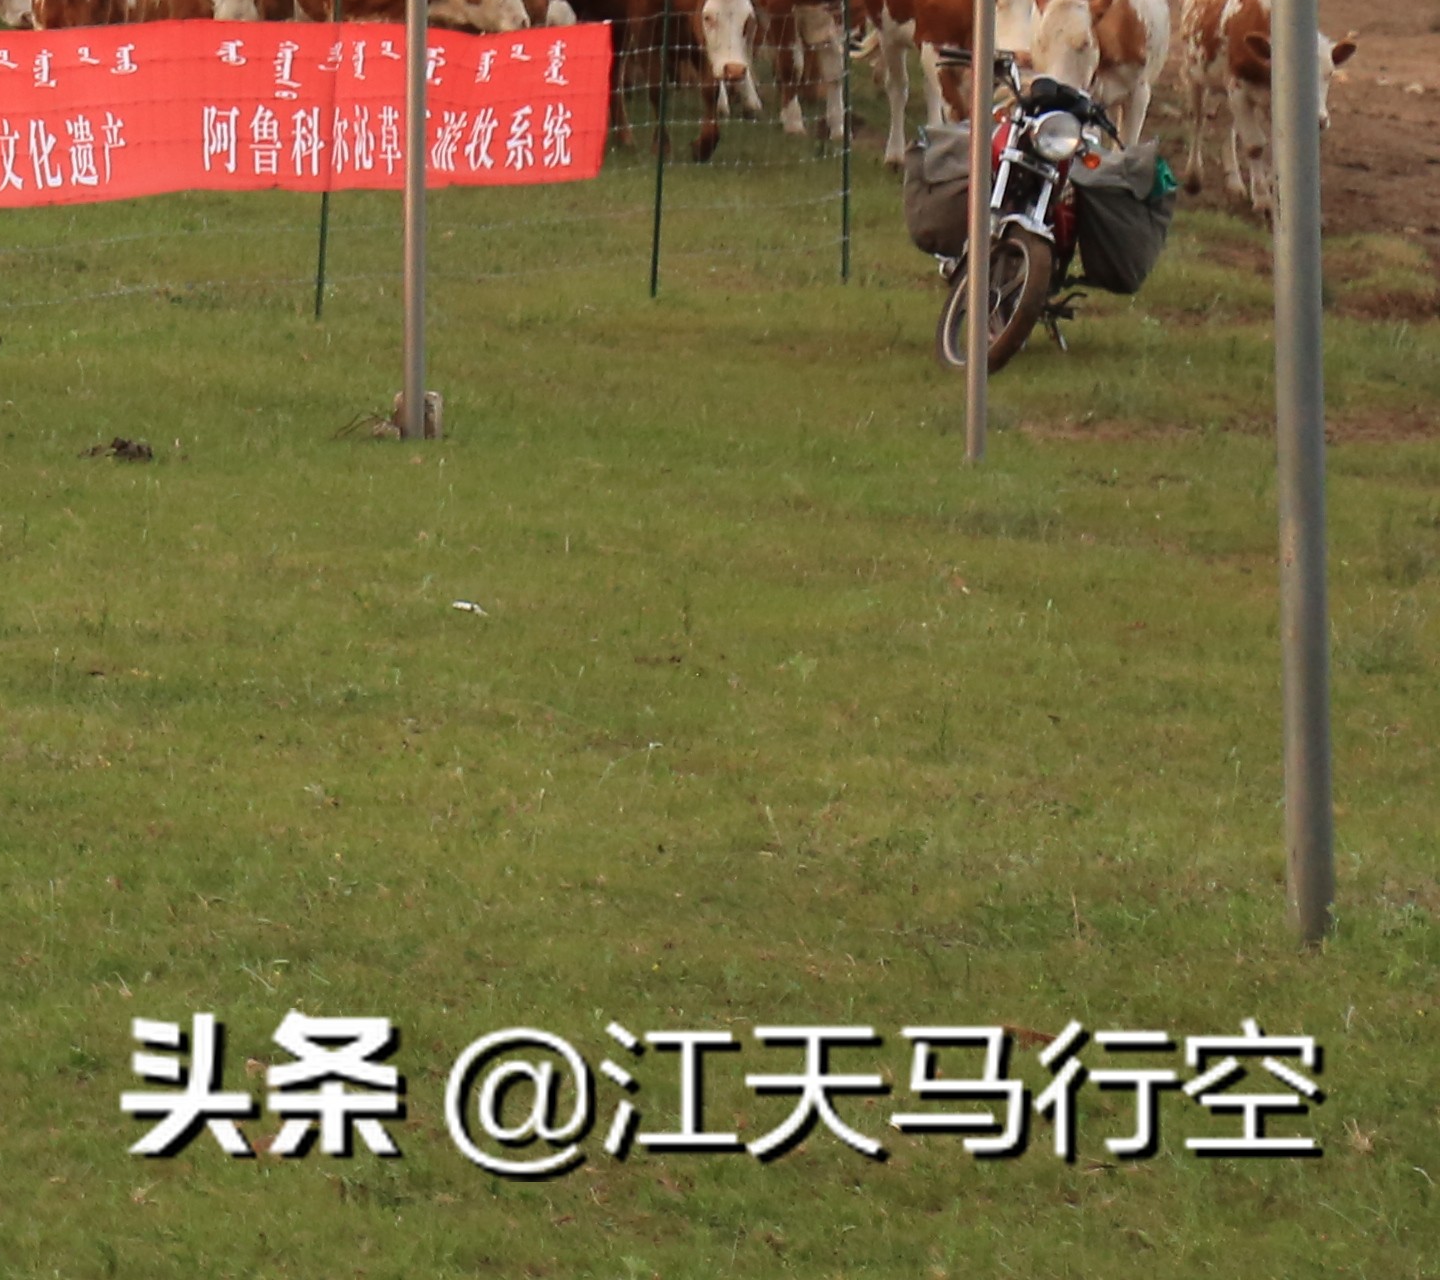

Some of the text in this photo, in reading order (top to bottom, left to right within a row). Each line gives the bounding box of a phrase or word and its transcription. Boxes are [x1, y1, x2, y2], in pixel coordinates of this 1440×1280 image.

[202, 102, 573, 177] 阿鲁科尔沁草游牧系统
